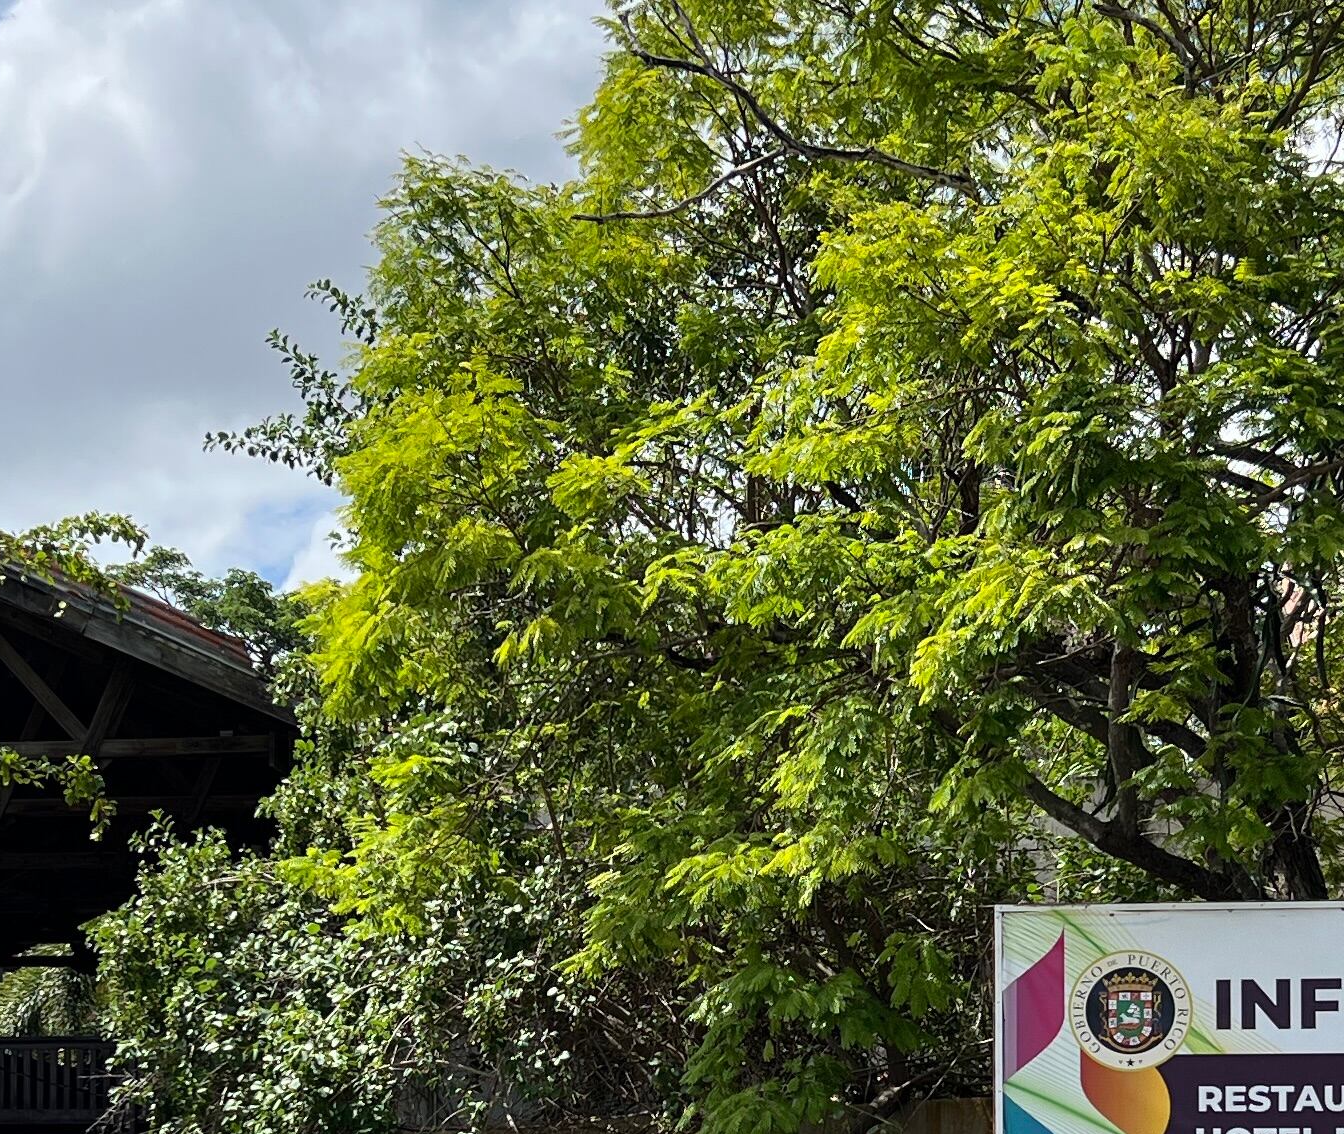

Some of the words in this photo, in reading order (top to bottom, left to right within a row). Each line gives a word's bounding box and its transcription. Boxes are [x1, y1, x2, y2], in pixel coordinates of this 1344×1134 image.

[1073, 966, 1103, 1054] GOBIERNO
[1127, 954, 1187, 999] PUERTO
[1164, 1008, 1189, 1051] RICO
